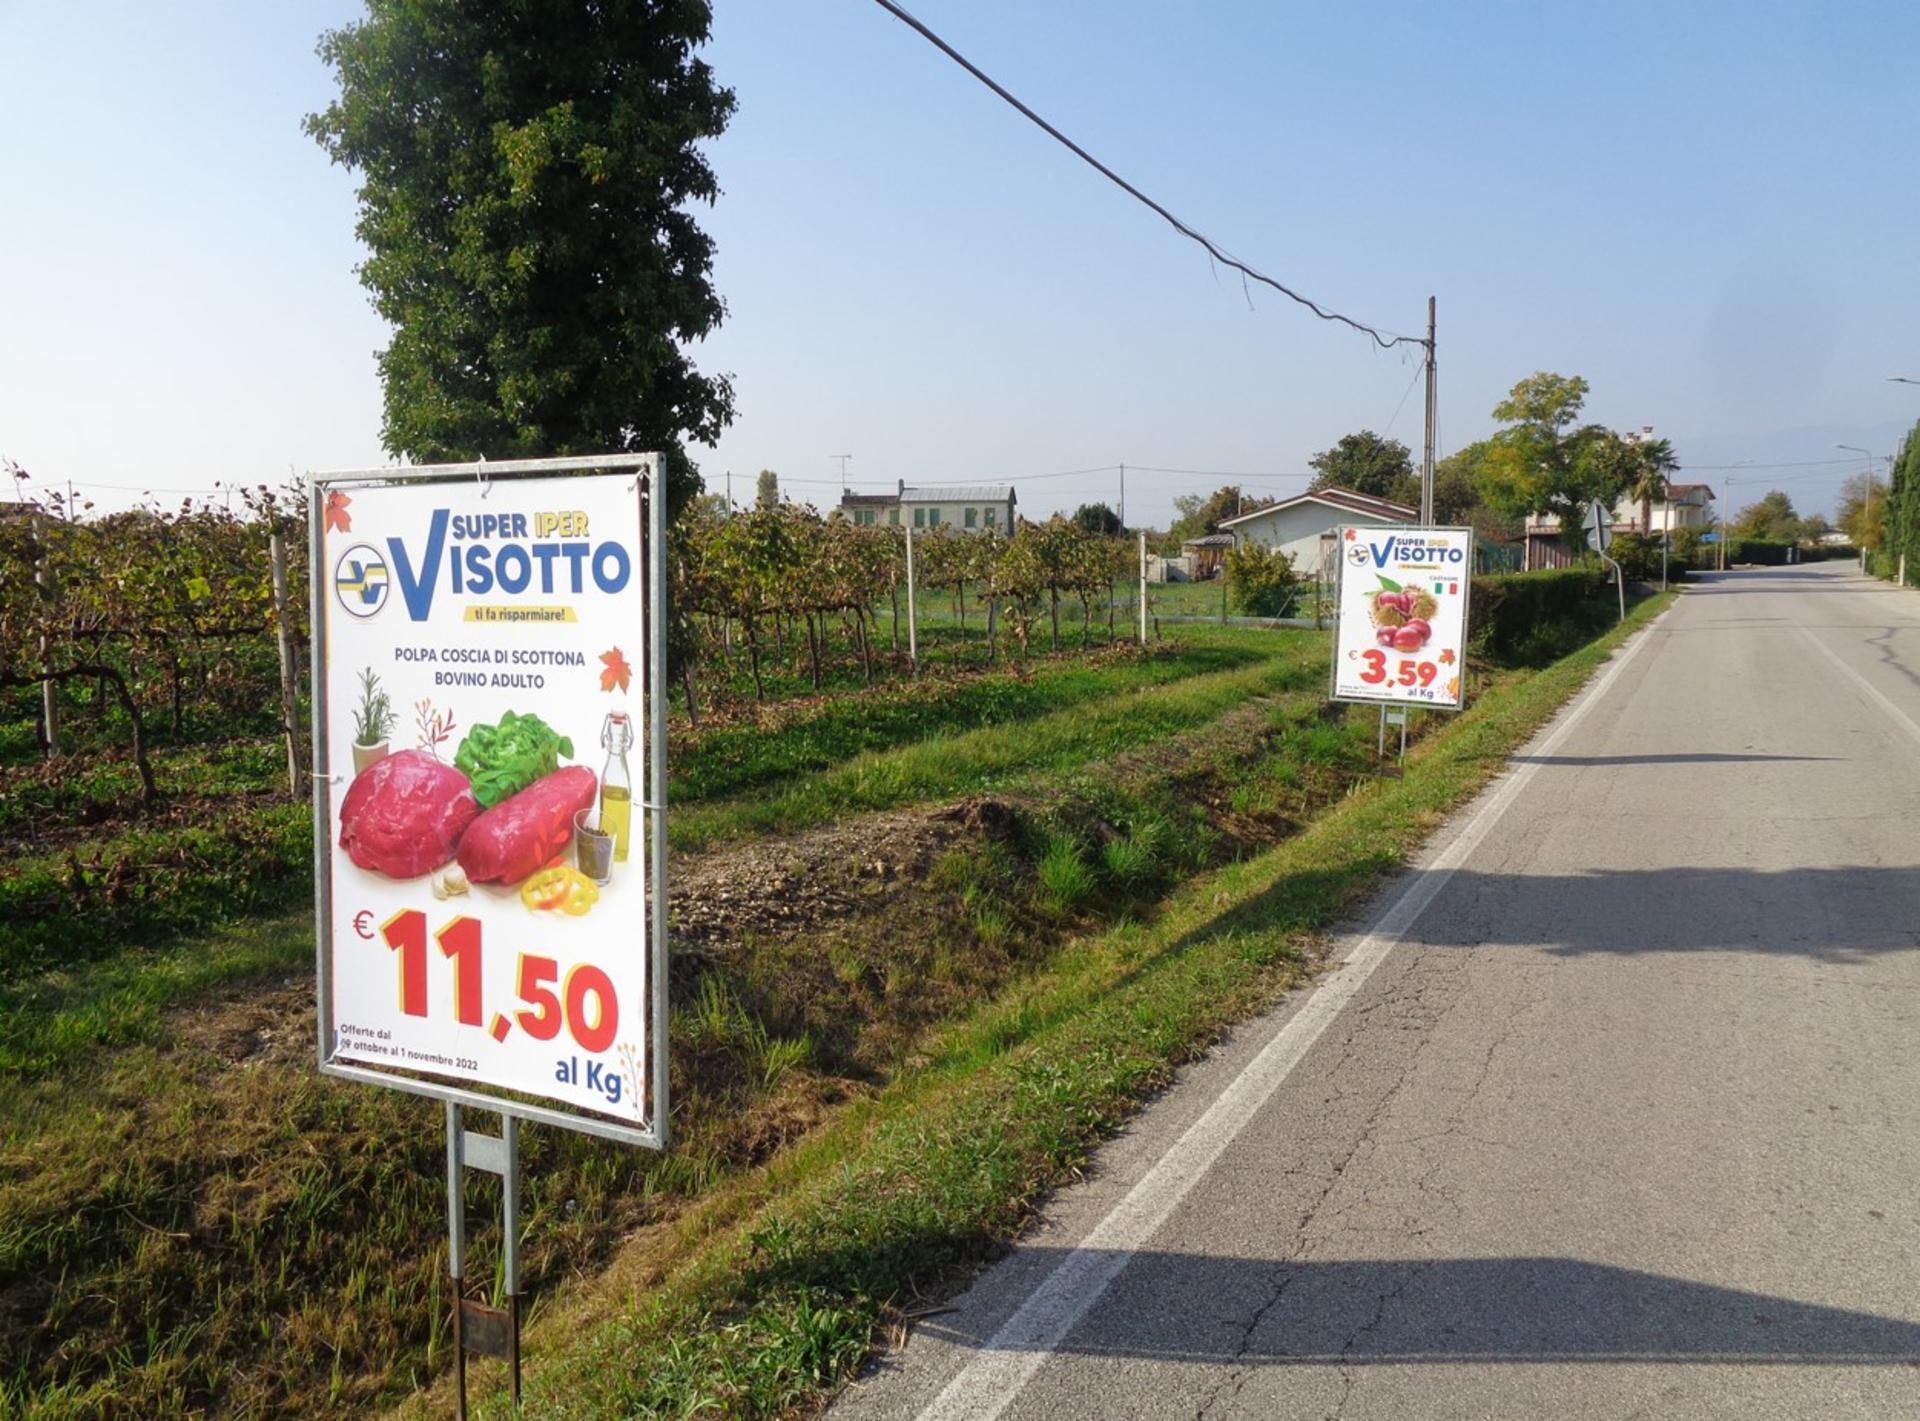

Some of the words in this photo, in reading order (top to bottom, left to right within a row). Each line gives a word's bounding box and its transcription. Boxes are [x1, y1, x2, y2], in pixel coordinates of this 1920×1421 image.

[452, 512, 528, 541] SUPER
[534, 511, 590, 538] IPER
[1370, 536, 1463, 568] VISOTTO
[1396, 538, 1425, 547] SUPER
[386, 508, 631, 622] VISOTTO
[475, 607, 483, 620] ti
[486, 607, 496, 620] fa
[499, 607, 566, 622] risparmiare!
[395, 647, 438, 663] POLPA
[441, 649, 491, 664] COSCIA
[494, 650, 509, 664] DI
[511, 650, 586, 666] SCOTTONA
[1360, 649, 1438, 688] 3,59
[435, 671, 488, 688] BOVINO
[491, 673, 545, 689] ADULTO
[1408, 688, 1418, 696] al
[1420, 688, 1434, 699] Kg
[353, 909, 375, 940] €
[379, 908, 619, 1053] 11,50
[340, 1024, 375, 1038] Offerte
[377, 1029, 392, 1040] dal
[354, 1041, 388, 1055] ottobre
[390, 1046, 399, 1057] al
[401, 1047, 406, 1057] 1
[407, 1050, 454, 1066] novembre
[456, 1057, 479, 1071] 2022
[556, 1056, 578, 1086] al
[587, 1060, 622, 1103] Kg
